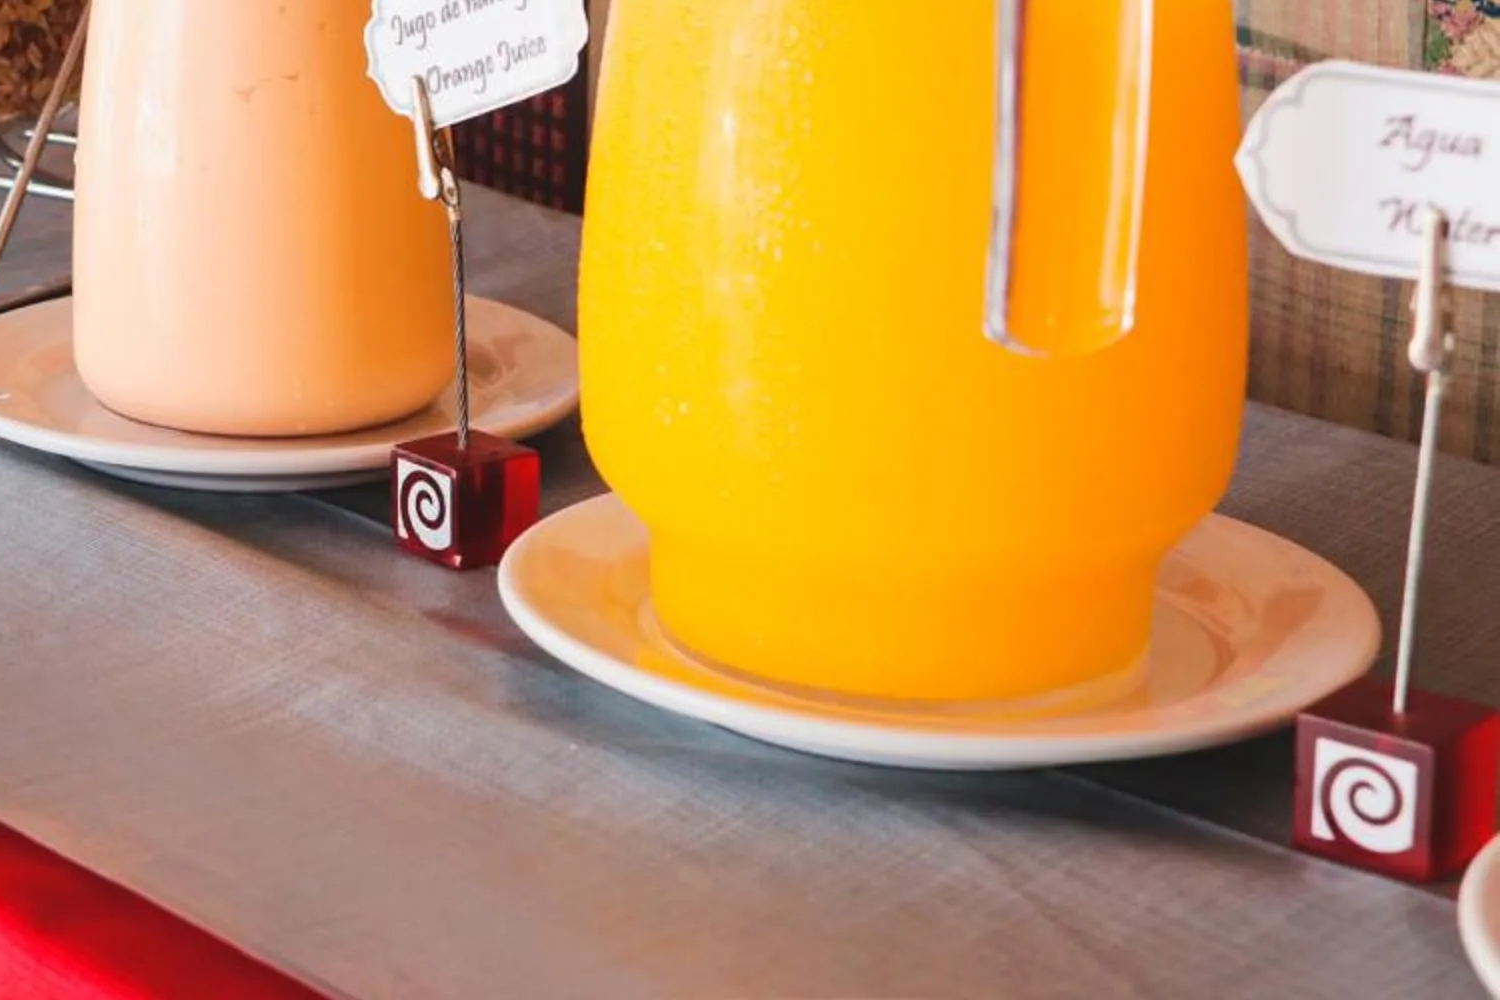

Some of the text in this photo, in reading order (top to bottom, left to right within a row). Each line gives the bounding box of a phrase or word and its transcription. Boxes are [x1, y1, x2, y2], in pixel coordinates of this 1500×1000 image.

[391, 10, 436, 50] Jugo
[426, 34, 547, 95] Orange Juice
[1378, 115, 1483, 172] Agua
[1378, 197, 1500, 245] Wter
